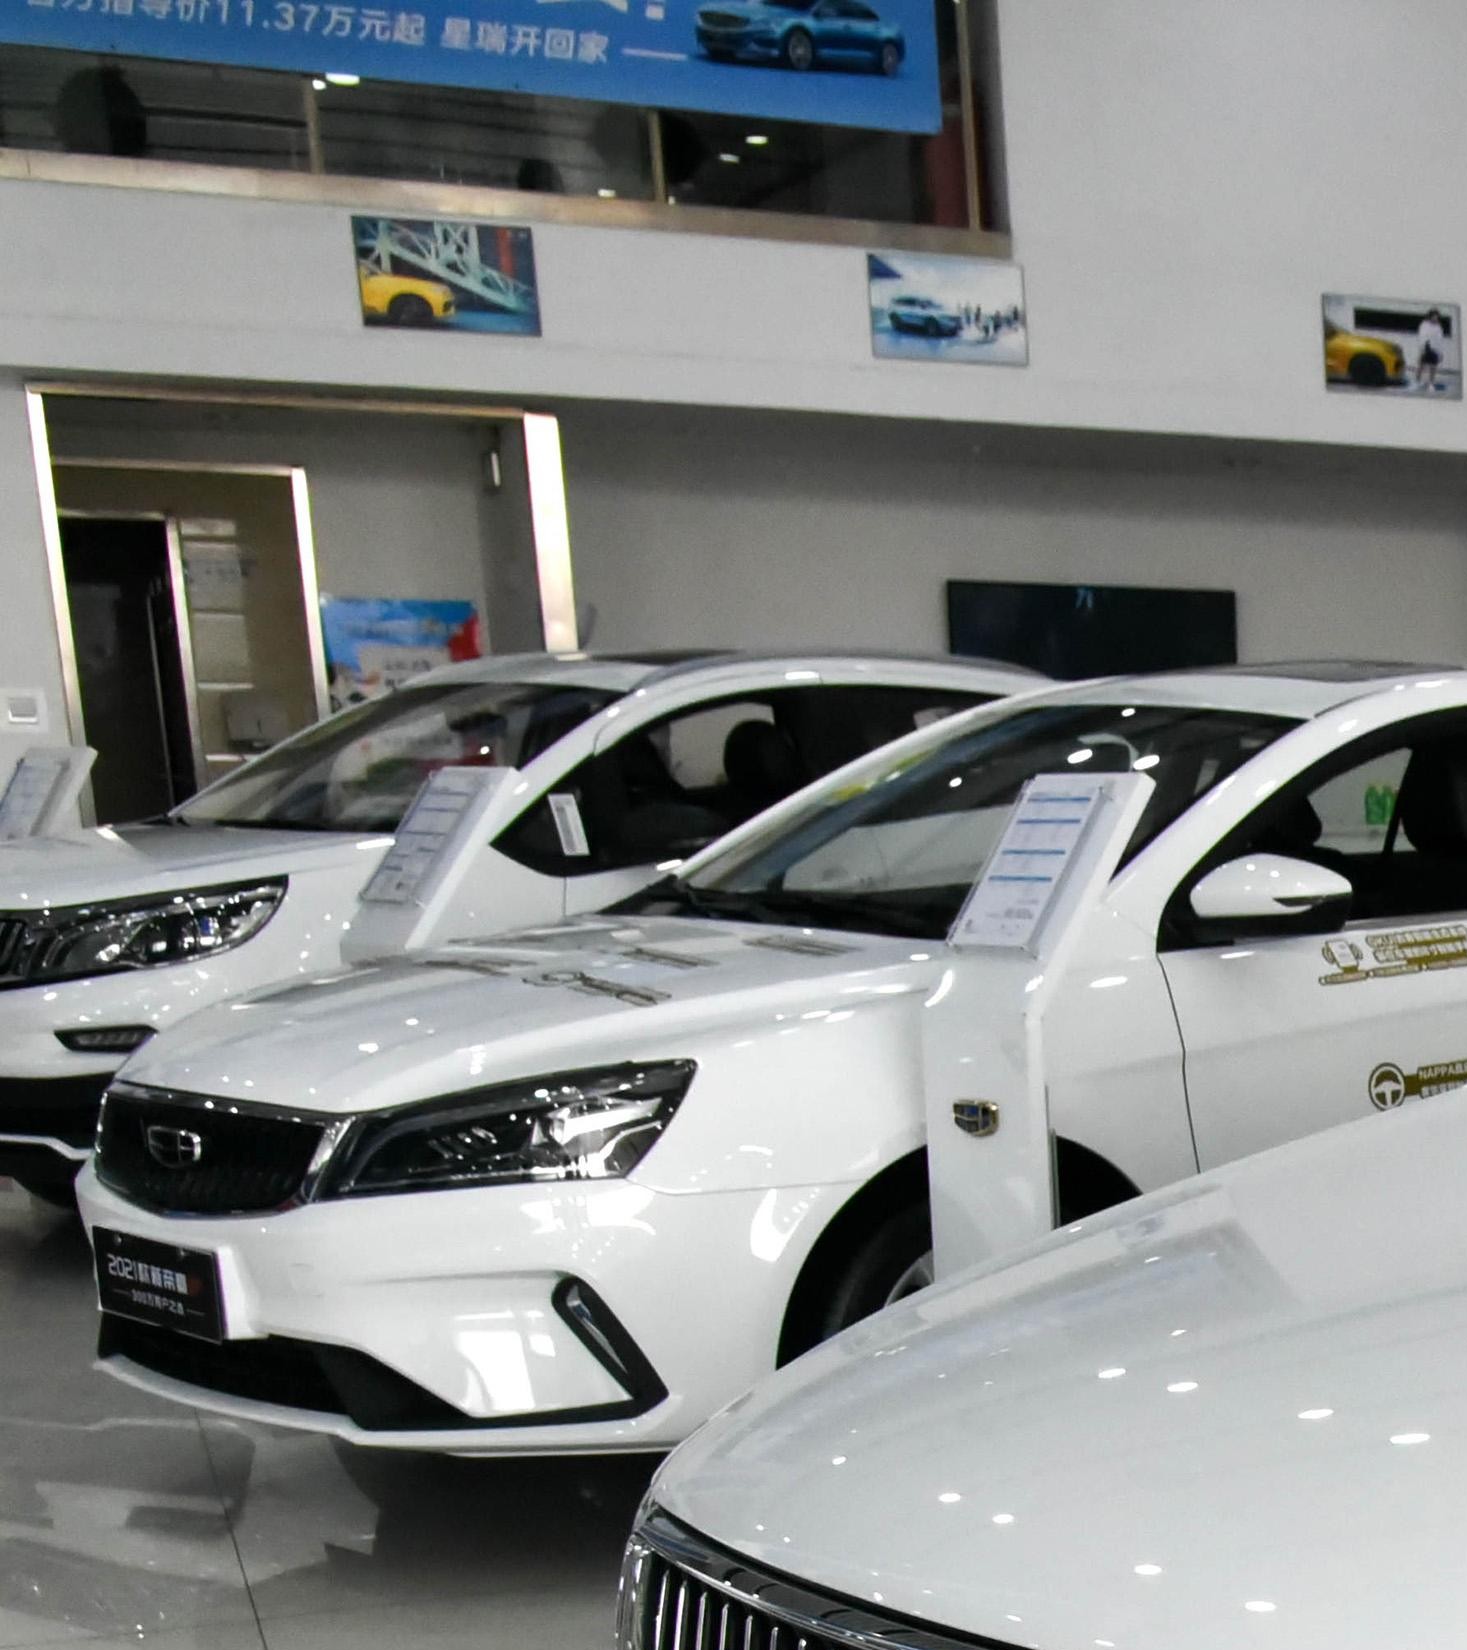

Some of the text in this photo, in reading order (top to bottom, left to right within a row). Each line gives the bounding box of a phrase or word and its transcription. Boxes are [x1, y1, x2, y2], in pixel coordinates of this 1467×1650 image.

[441, 16, 609, 63] 星瑞开回家
